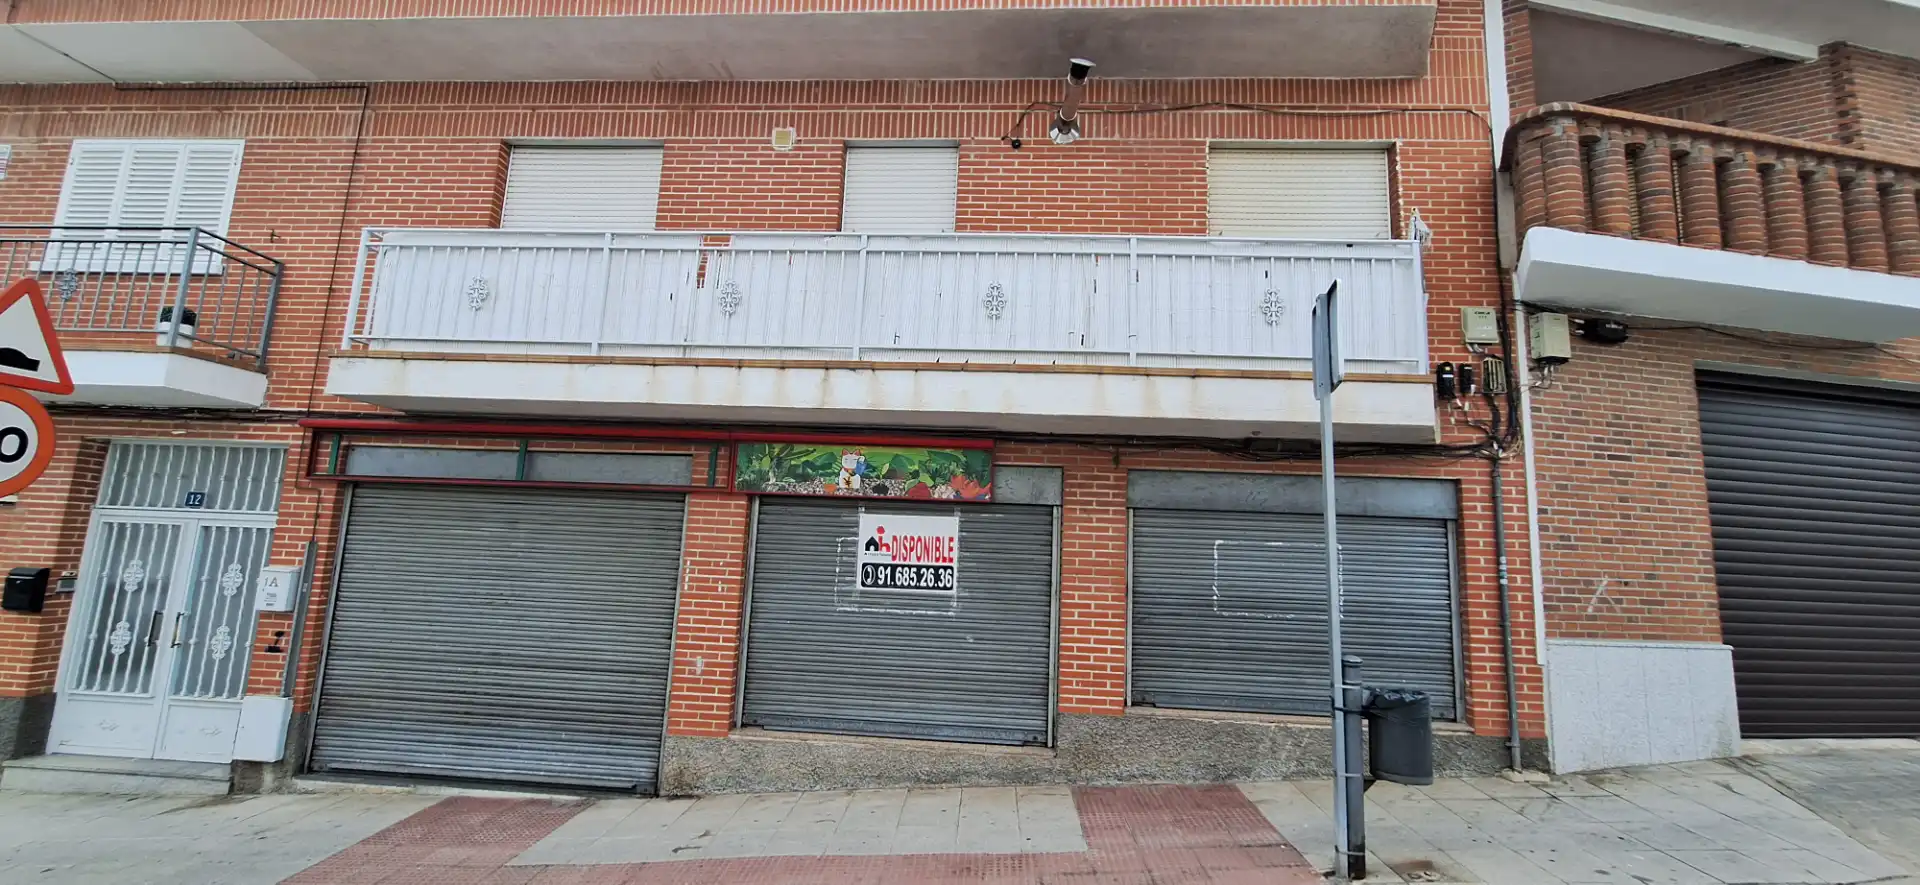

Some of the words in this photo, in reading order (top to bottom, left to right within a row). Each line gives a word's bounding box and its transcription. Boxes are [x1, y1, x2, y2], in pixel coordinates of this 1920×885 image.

[189, 494, 202, 505] 12
[891, 535, 955, 563] DISPONIBLE
[877, 566, 953, 588] 91.685.26.36
